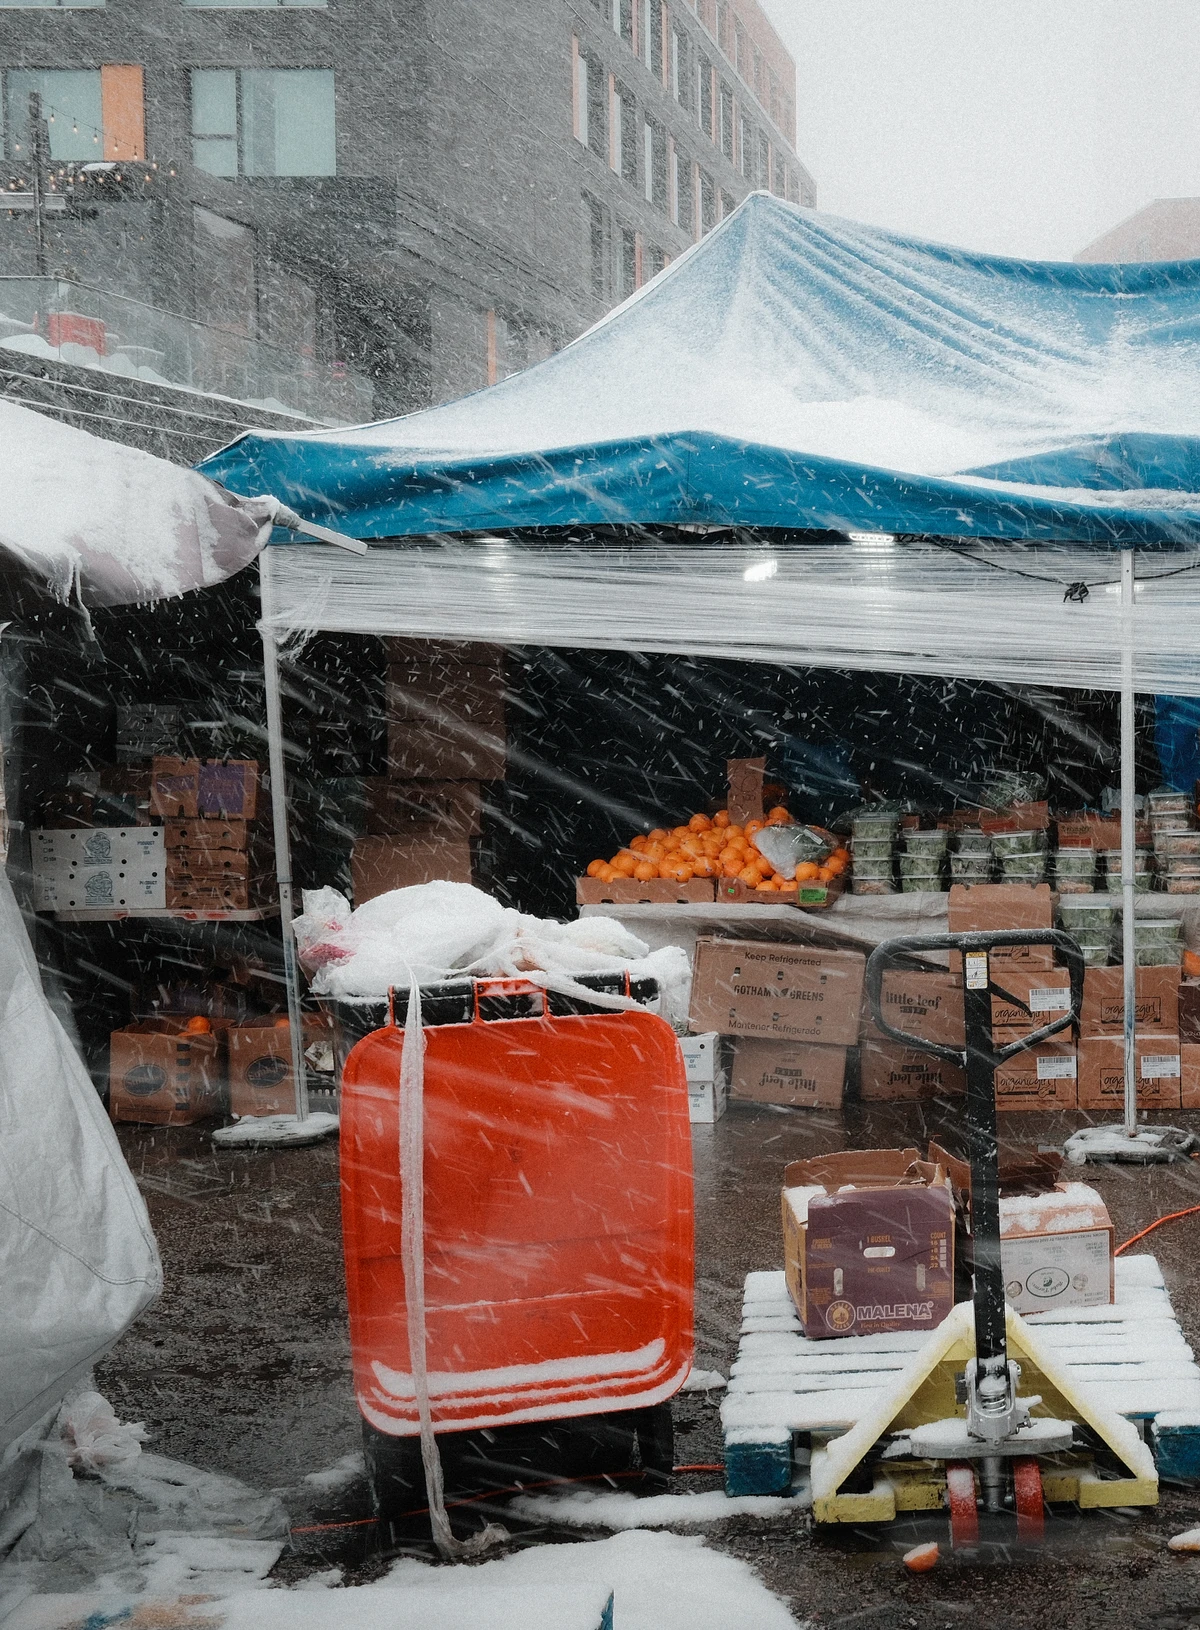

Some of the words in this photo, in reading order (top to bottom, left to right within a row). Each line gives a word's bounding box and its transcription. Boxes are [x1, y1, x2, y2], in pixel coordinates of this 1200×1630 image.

[744, 952, 767, 963] Keep
[769, 953, 822, 967] Refrigerated
[734, 984, 771, 997] GOTHAM
[790, 990, 824, 1002] GREENS
[886, 991, 914, 1006] little
[917, 995, 942, 1010] leaf
[1104, 1002, 1156, 1020] orgacgirl
[772, 1023, 821, 1036] Refrigerado
[758, 1072, 784, 1088] leaf
[788, 1078, 816, 1092] little
[930, 1231, 946, 1239] COUNT
[857, 1302, 933, 1320] MALENA
